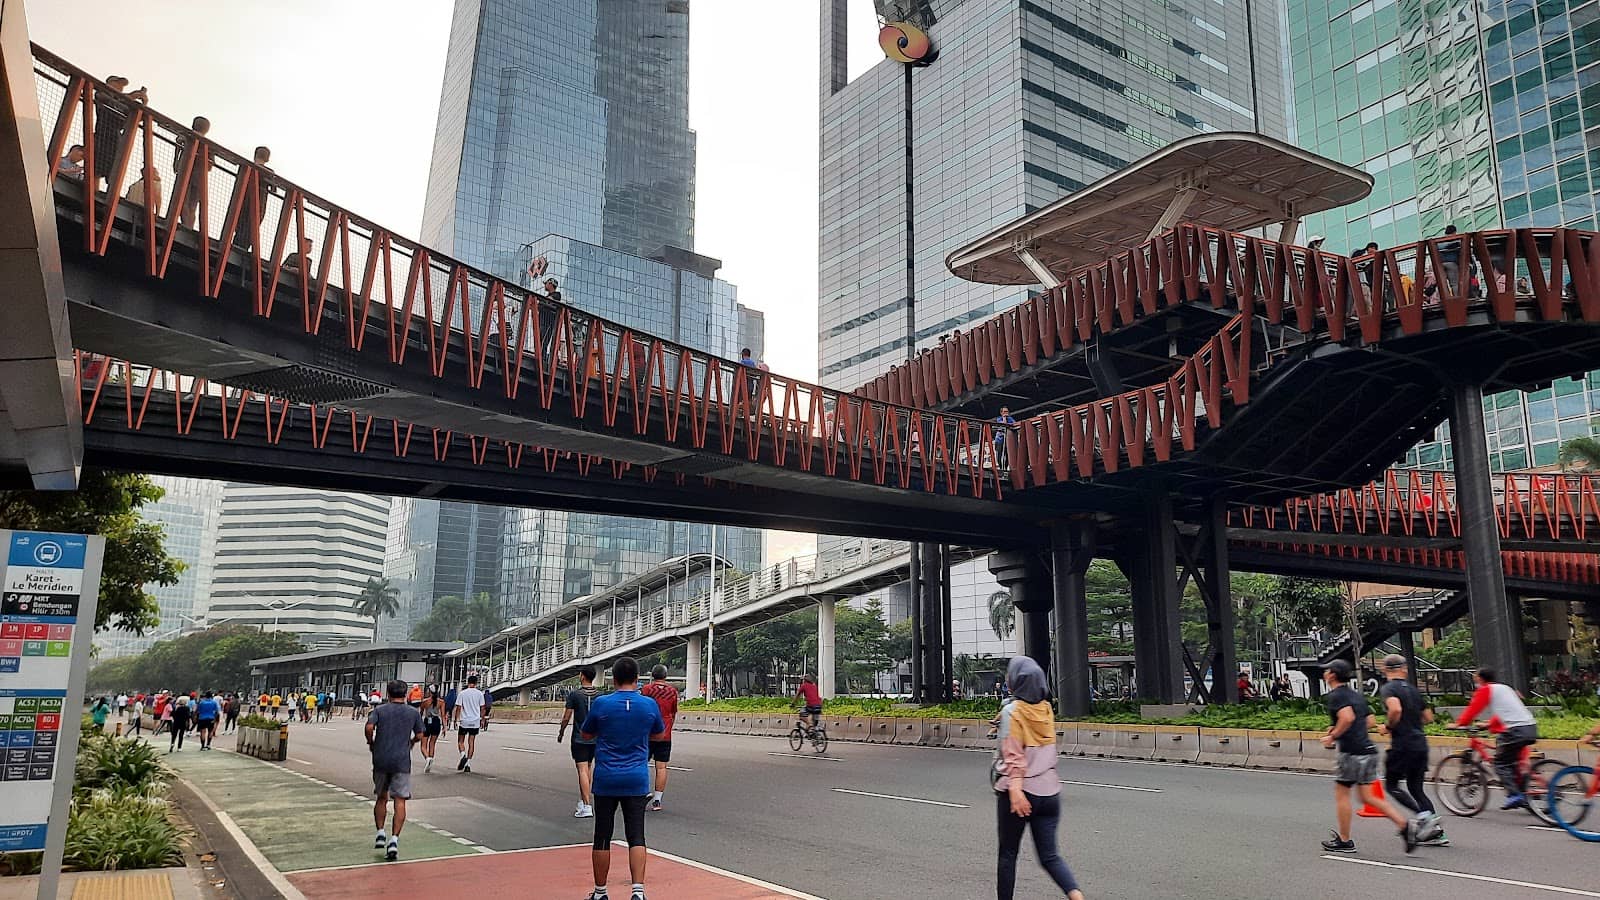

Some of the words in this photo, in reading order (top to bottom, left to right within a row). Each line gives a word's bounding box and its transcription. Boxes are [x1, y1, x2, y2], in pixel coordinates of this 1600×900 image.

[26, 574, 54, 582] Karet
[12, 582, 24, 590] Le
[28, 583, 73, 592] Meridien
[32, 602, 72, 610] Bendungan
